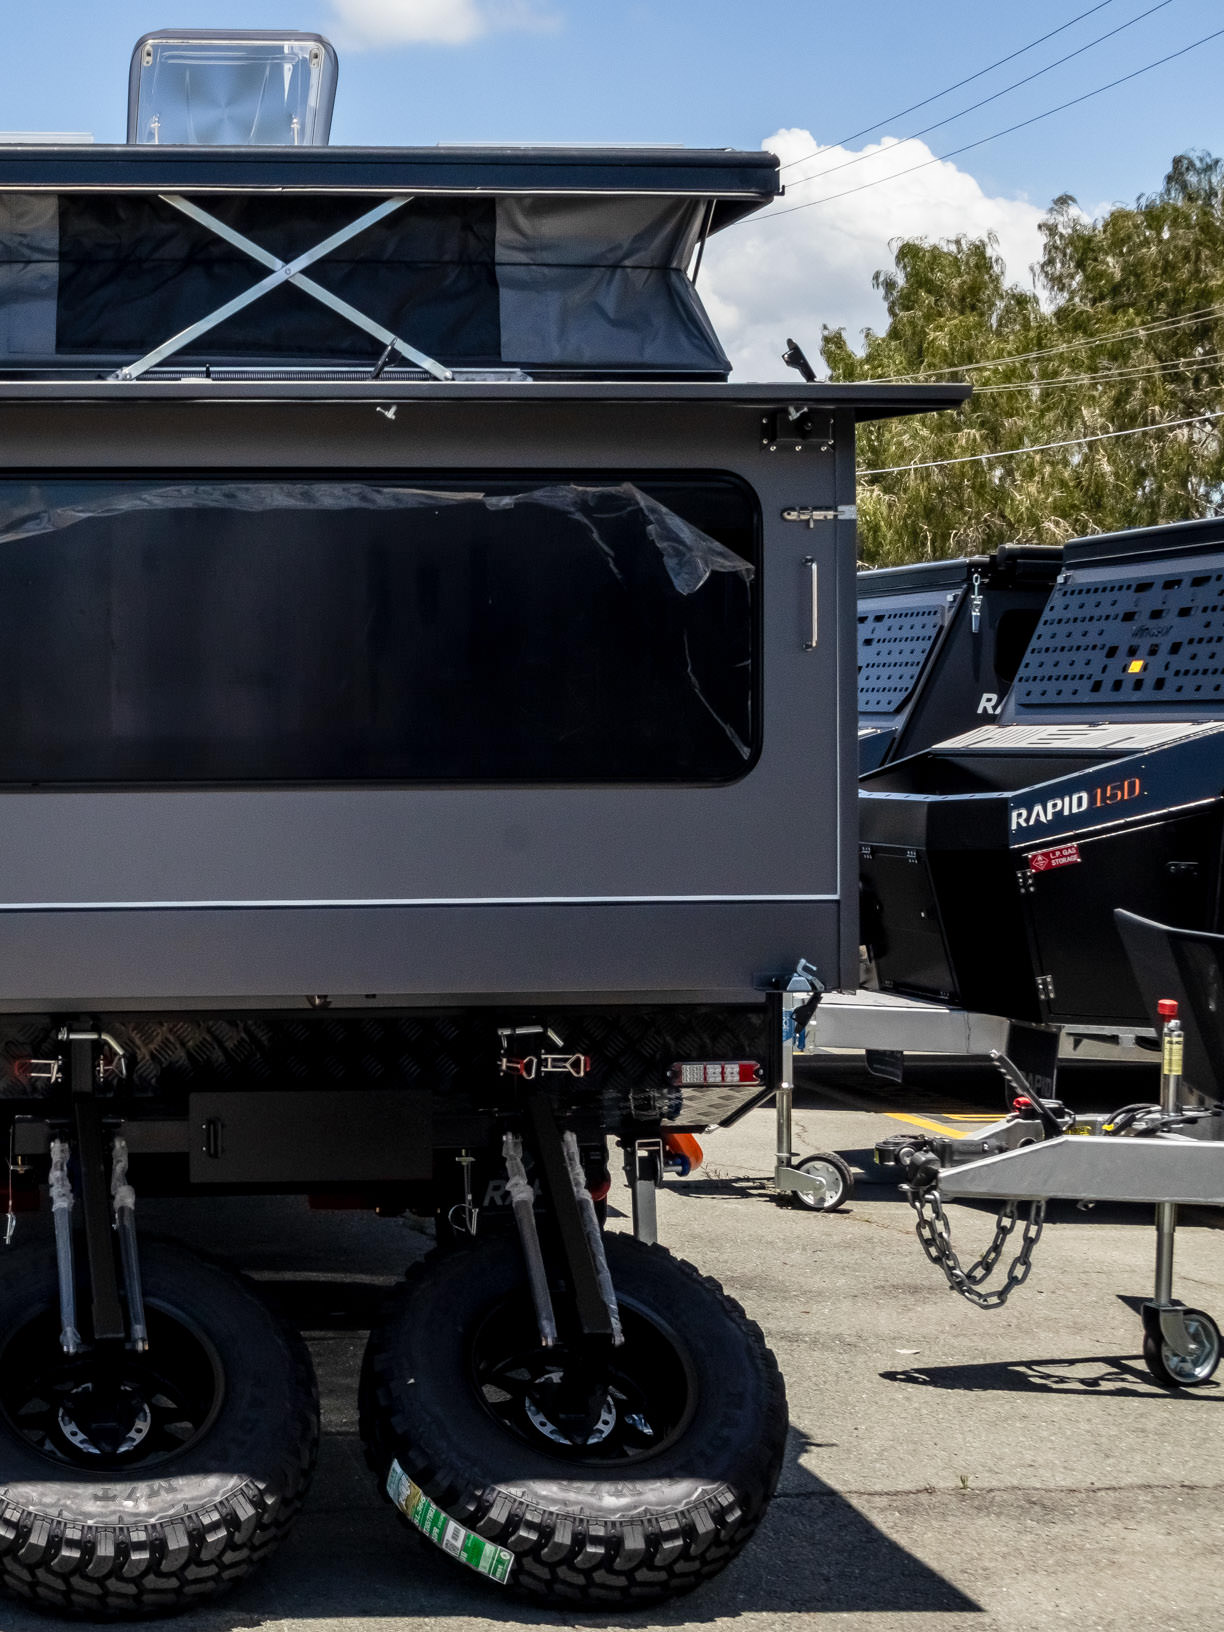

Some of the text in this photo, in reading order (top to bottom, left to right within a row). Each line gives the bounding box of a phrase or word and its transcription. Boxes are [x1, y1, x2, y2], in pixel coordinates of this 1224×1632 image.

[1010, 790, 1088, 830] RAPID
[1062, 847, 1077, 856] GAS
[1051, 854, 1079, 866] STORAGE
